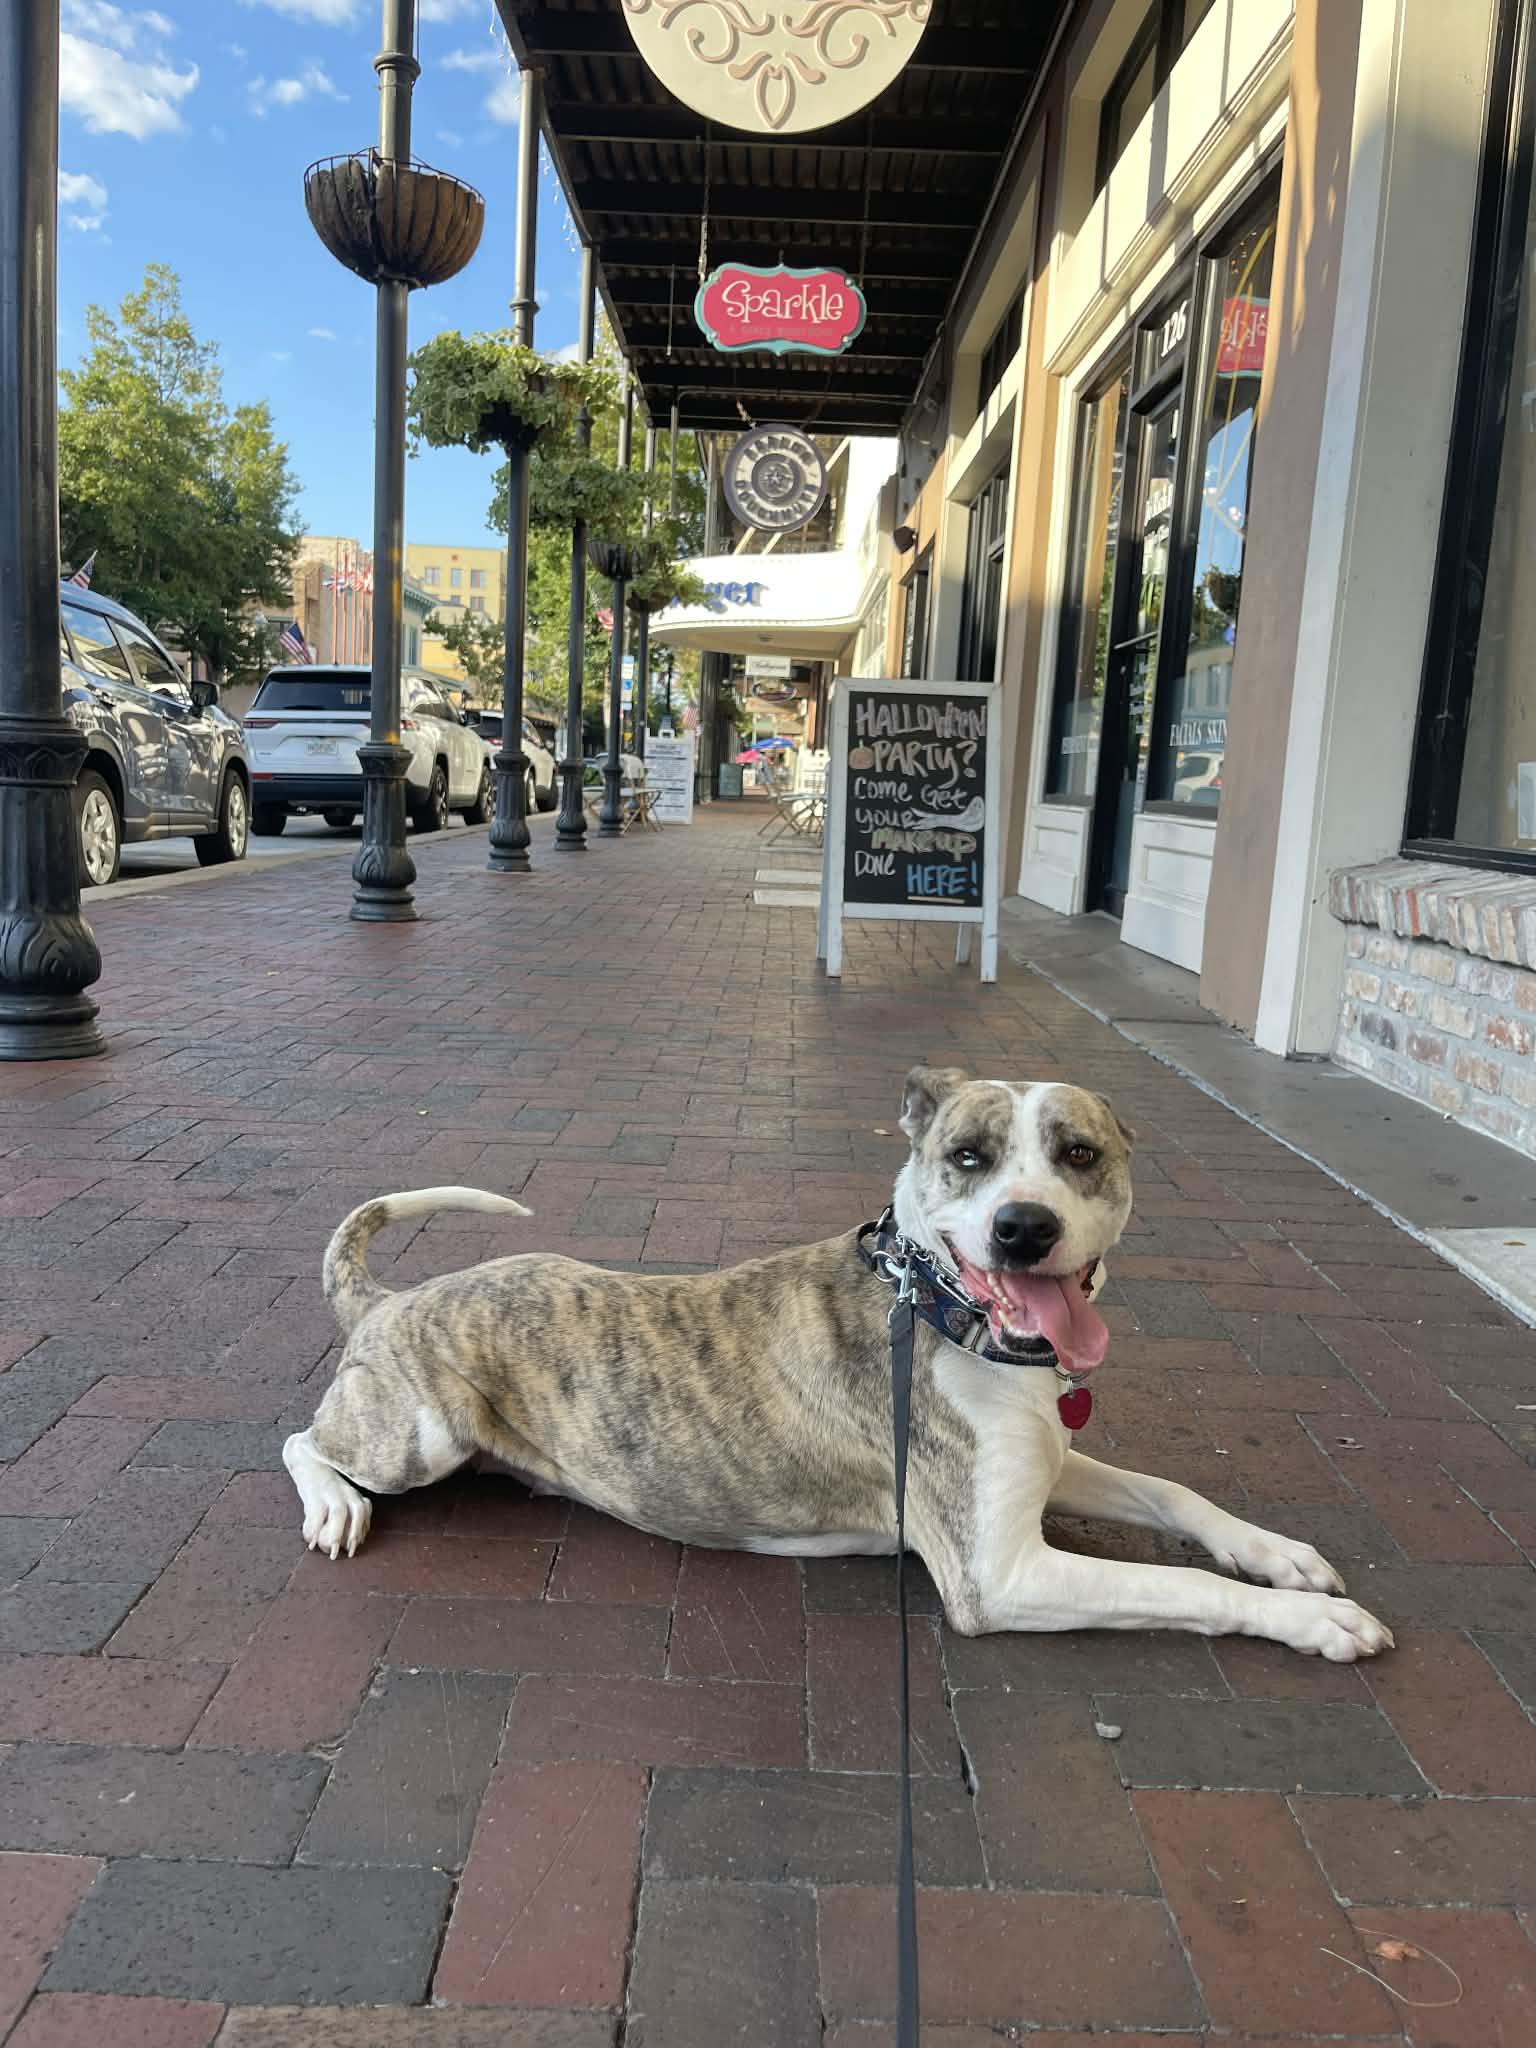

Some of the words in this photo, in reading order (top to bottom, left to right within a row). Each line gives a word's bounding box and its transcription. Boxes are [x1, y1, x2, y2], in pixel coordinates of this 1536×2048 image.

[721, 280, 844, 324] Sparkle
[1161, 300, 1187, 357] 126
[907, 860, 978, 896] HERE!
